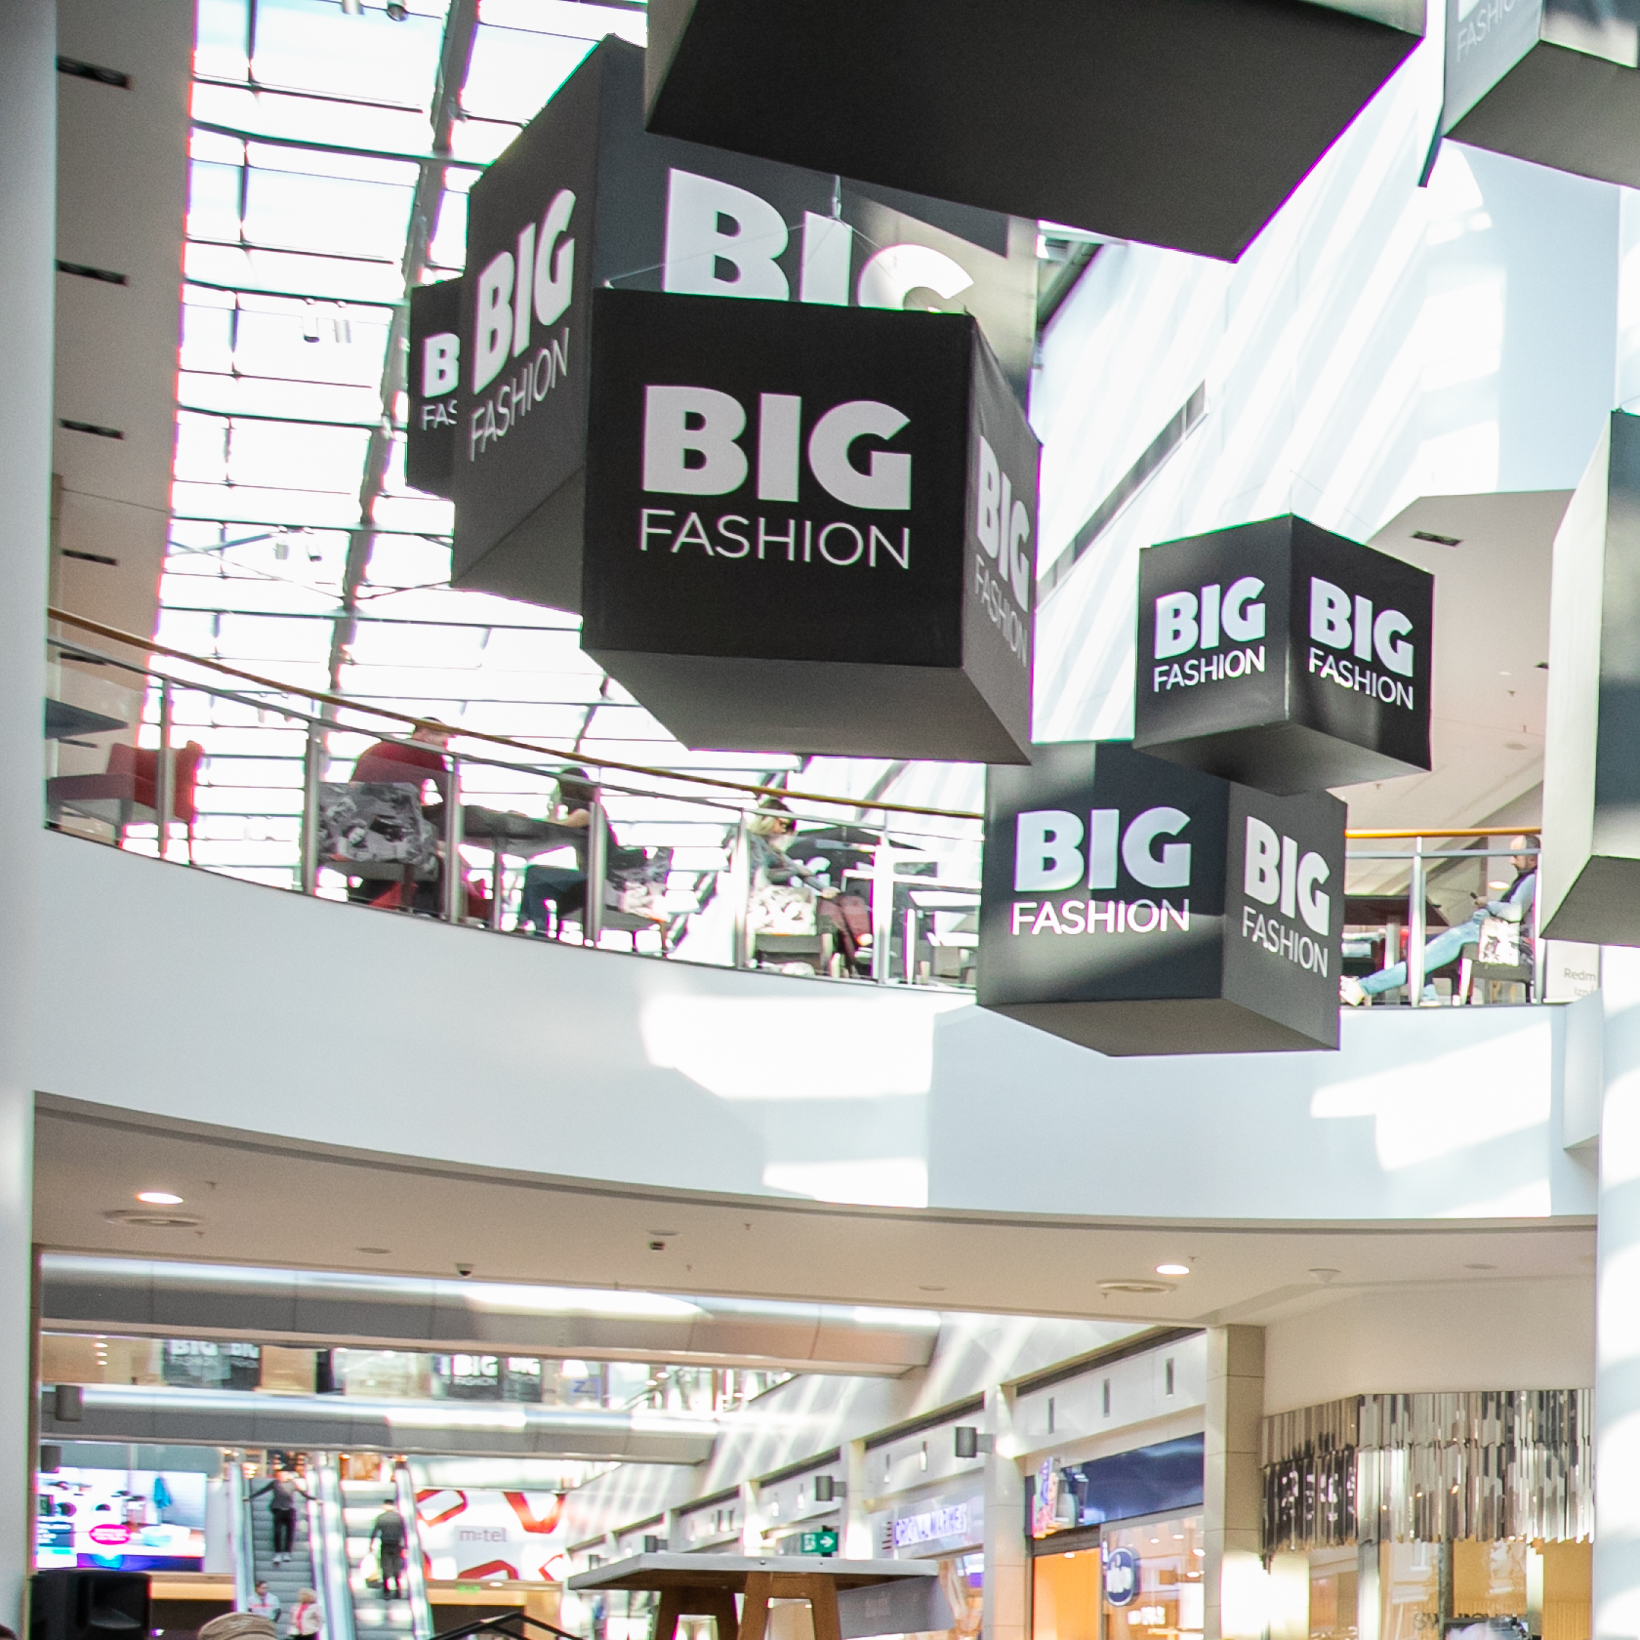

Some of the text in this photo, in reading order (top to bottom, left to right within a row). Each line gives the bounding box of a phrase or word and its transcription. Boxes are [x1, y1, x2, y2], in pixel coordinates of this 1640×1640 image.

[474, 189, 577, 395] BIG
[469, 328, 570, 462] FASHION
[642, 385, 912, 510] BIG
[639, 509, 911, 568] FASHION
[978, 436, 1030, 612] BIG
[976, 552, 1028, 668] FASHION
[1155, 577, 1265, 660] BIG
[1310, 577, 1414, 678] BIG
[1153, 645, 1265, 693] FASHION
[1308, 648, 1414, 710] FASHION
[1013, 808, 1191, 892] BIG
[1244, 816, 1330, 930] BIG
[1011, 898, 1191, 936] FASHION
[1241, 905, 1329, 978] FASHION
[1564, 967, 1596, 982] Redm
